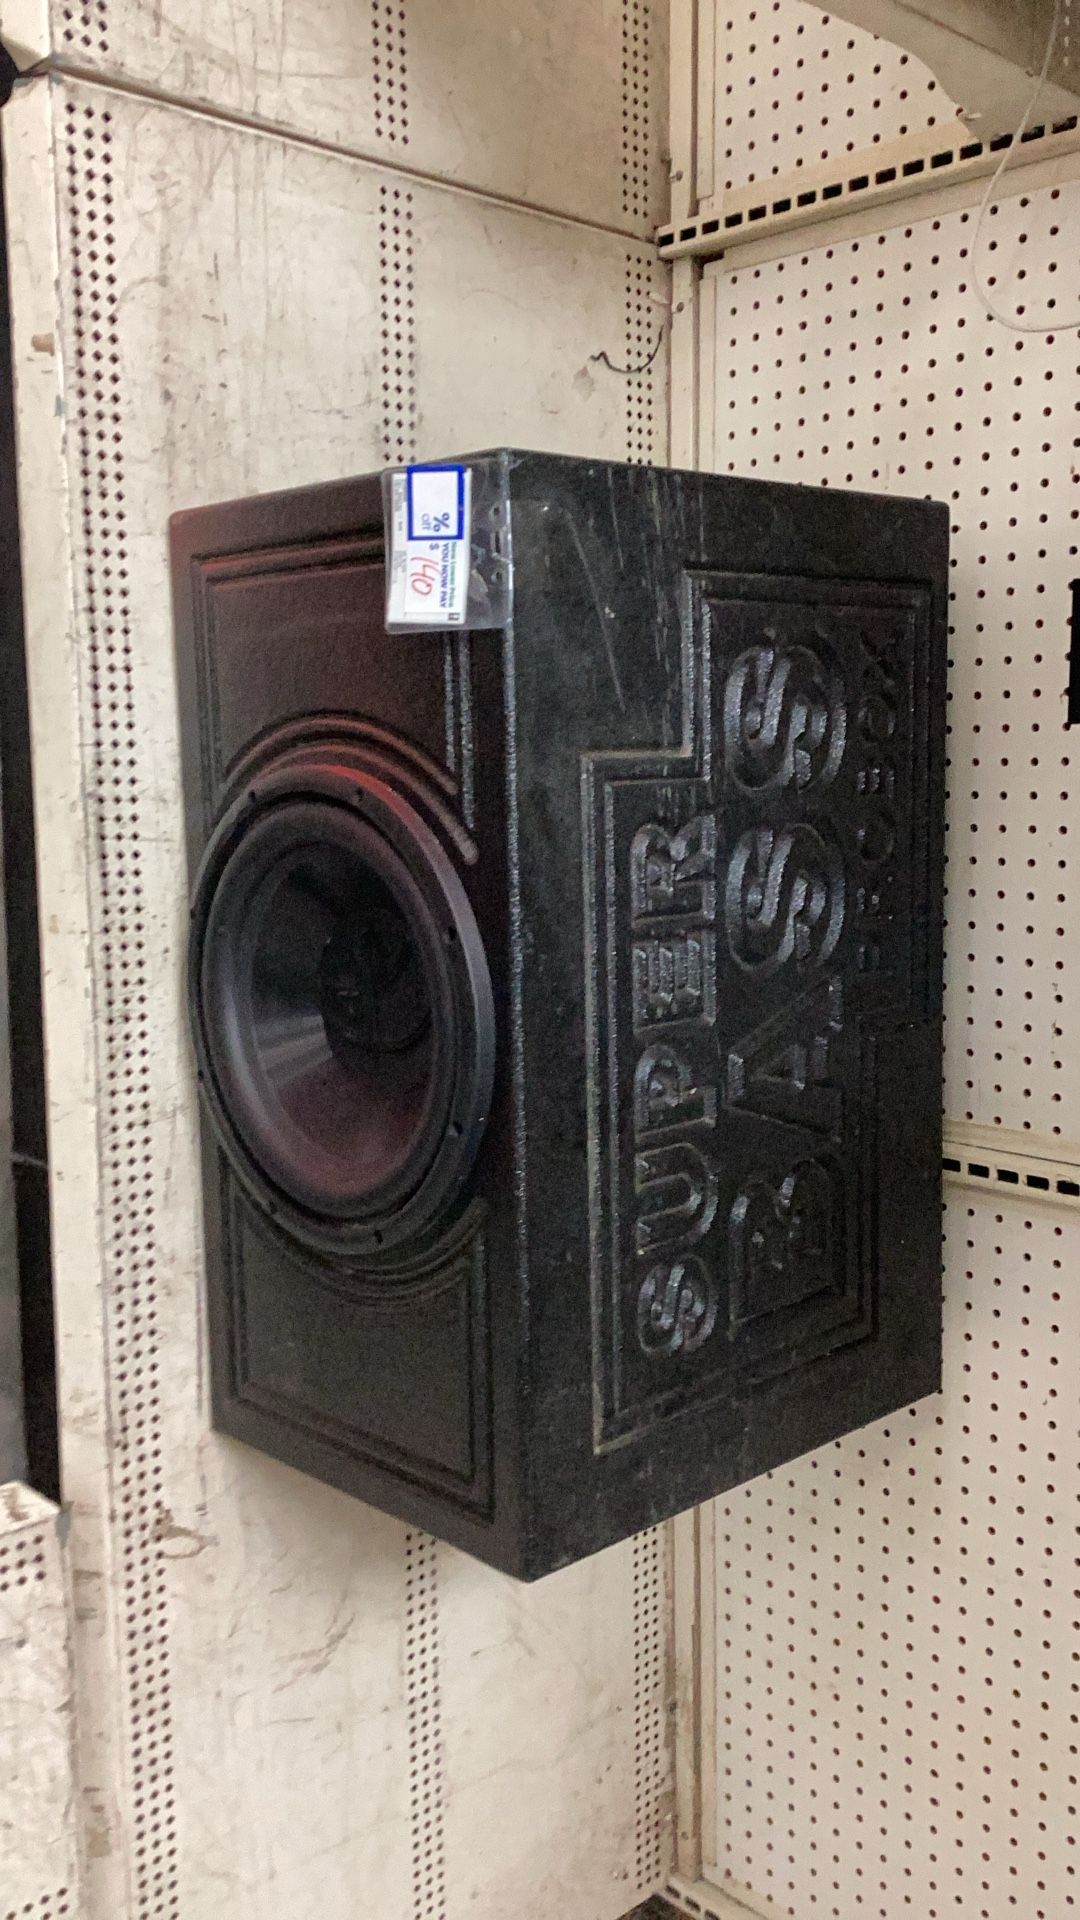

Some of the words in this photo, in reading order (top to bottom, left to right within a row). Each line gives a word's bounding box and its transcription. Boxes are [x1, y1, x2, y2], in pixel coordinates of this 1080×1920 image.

[421, 513, 432, 531] off
[432, 512, 450, 532] %
[441, 542, 449, 562] YOU
[722, 643, 846, 1342] BASS
[630, 813, 718, 1355] SUPER
